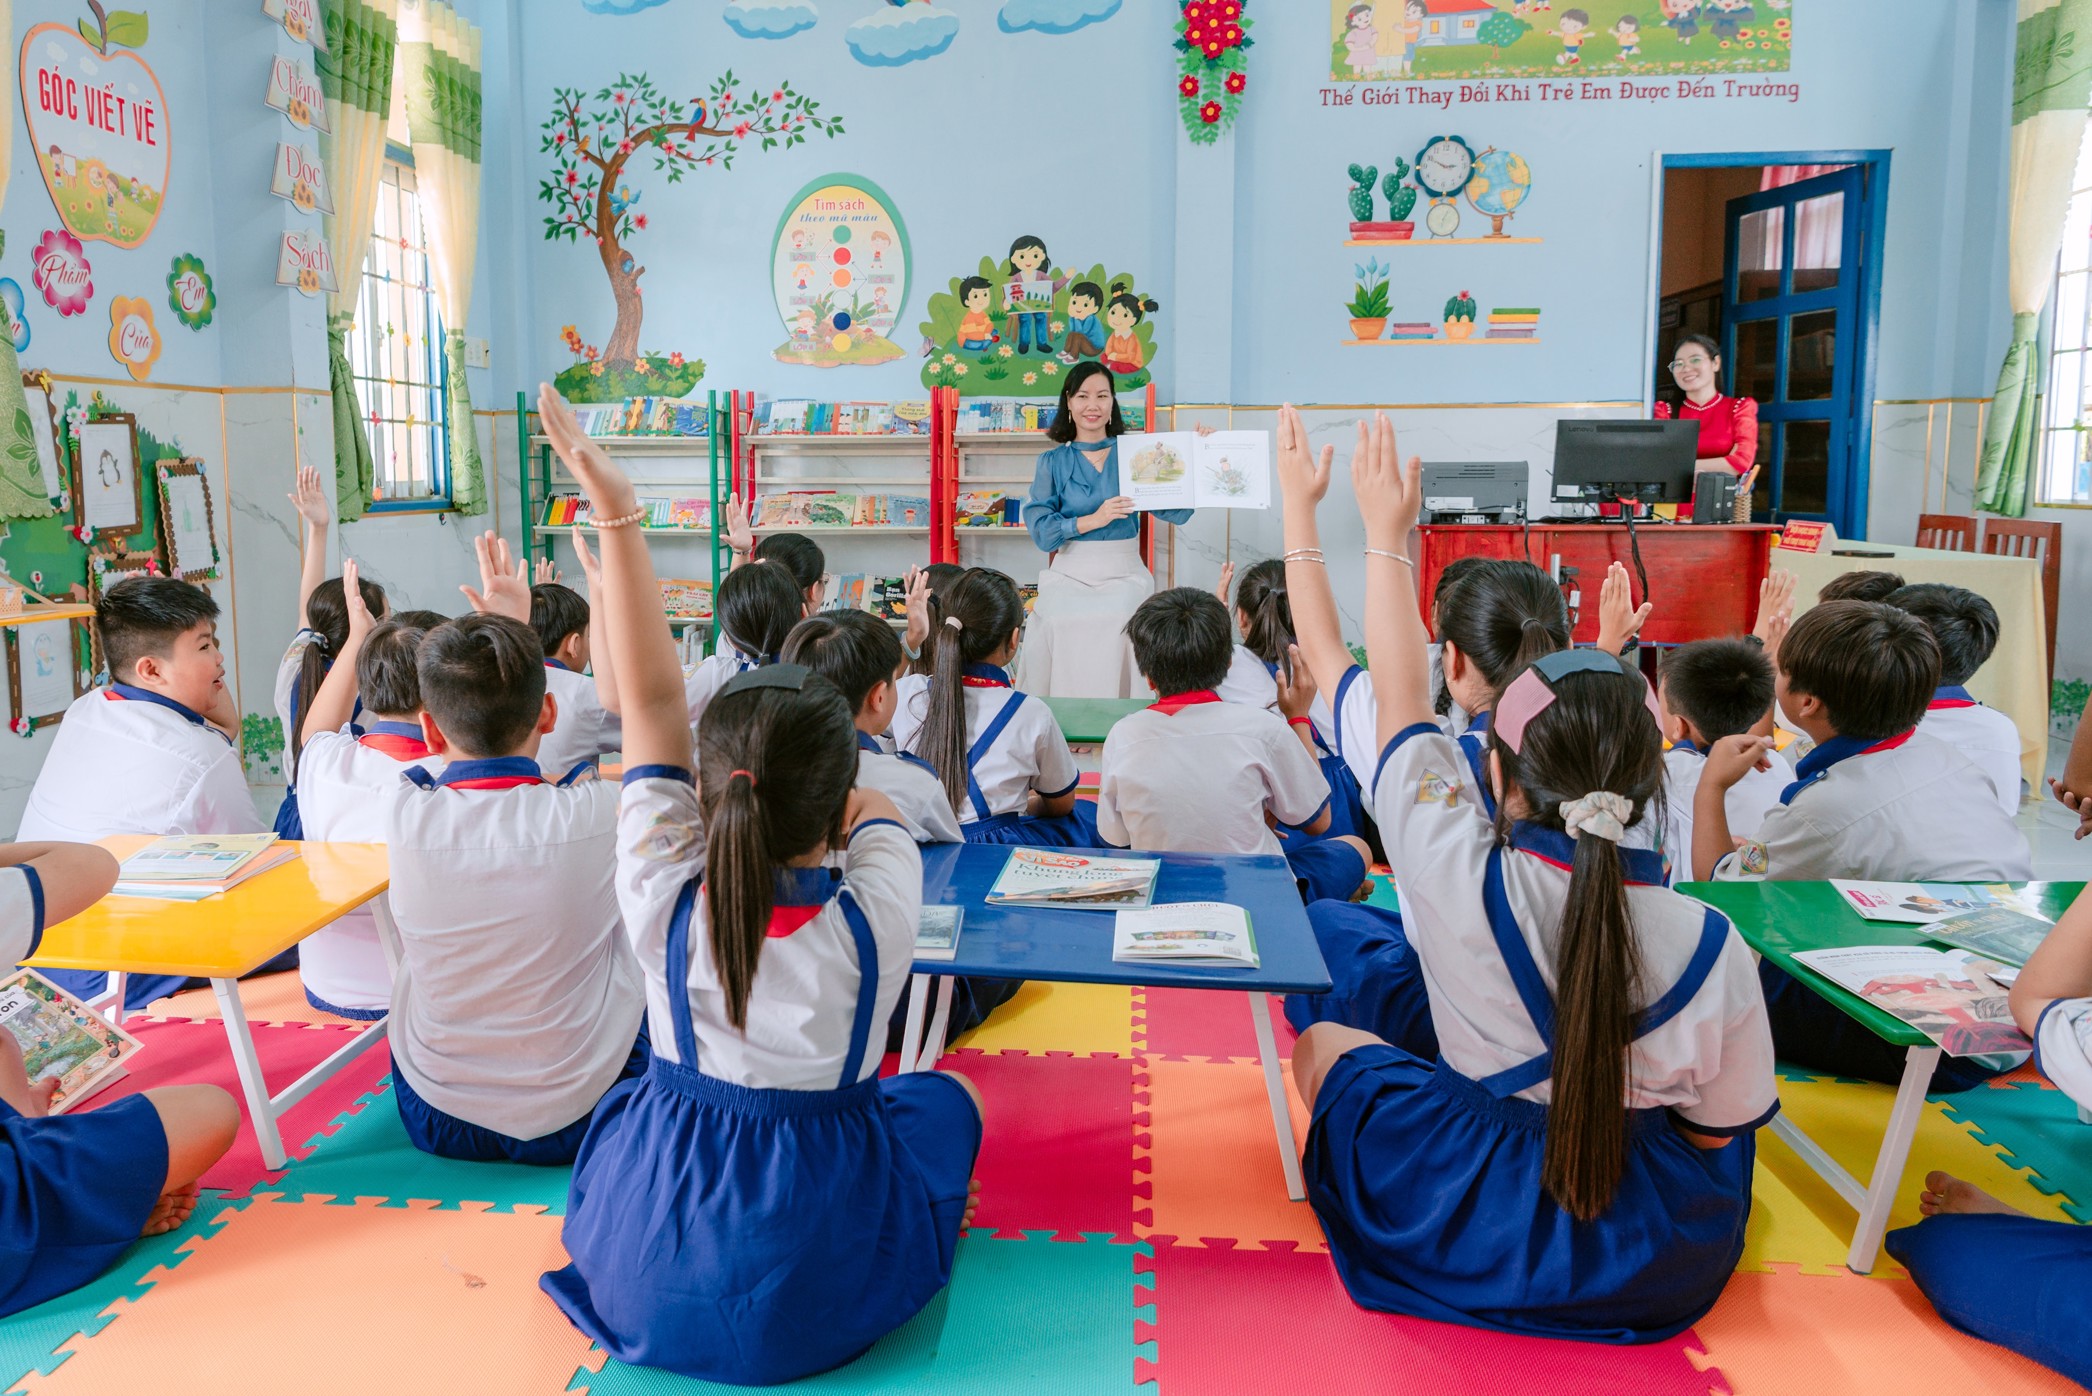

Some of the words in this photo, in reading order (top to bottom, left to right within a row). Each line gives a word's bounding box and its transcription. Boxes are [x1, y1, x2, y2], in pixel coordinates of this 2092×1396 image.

[38, 65, 77, 120] GÓC
[84, 82, 125, 136] VIẾT
[132, 99, 156, 146] VẼ
[1319, 85, 1355, 106] Thế
[1361, 86, 1400, 105] Giới
[1405, 87, 1454, 110] Thay
[1459, 82, 1490, 102] Đổi
[1496, 84, 1531, 101] Khi
[1538, 83, 1574, 100] Trẻ
[1619, 81, 1670, 103] Được
[1676, 77, 1716, 98] Đến
[1723, 77, 1799, 103] Trường
[839, 198, 865, 210] sách
[286, 235, 329, 272] Sách
[176, 277, 205, 311] Em
[121, 323, 150, 356] Của
